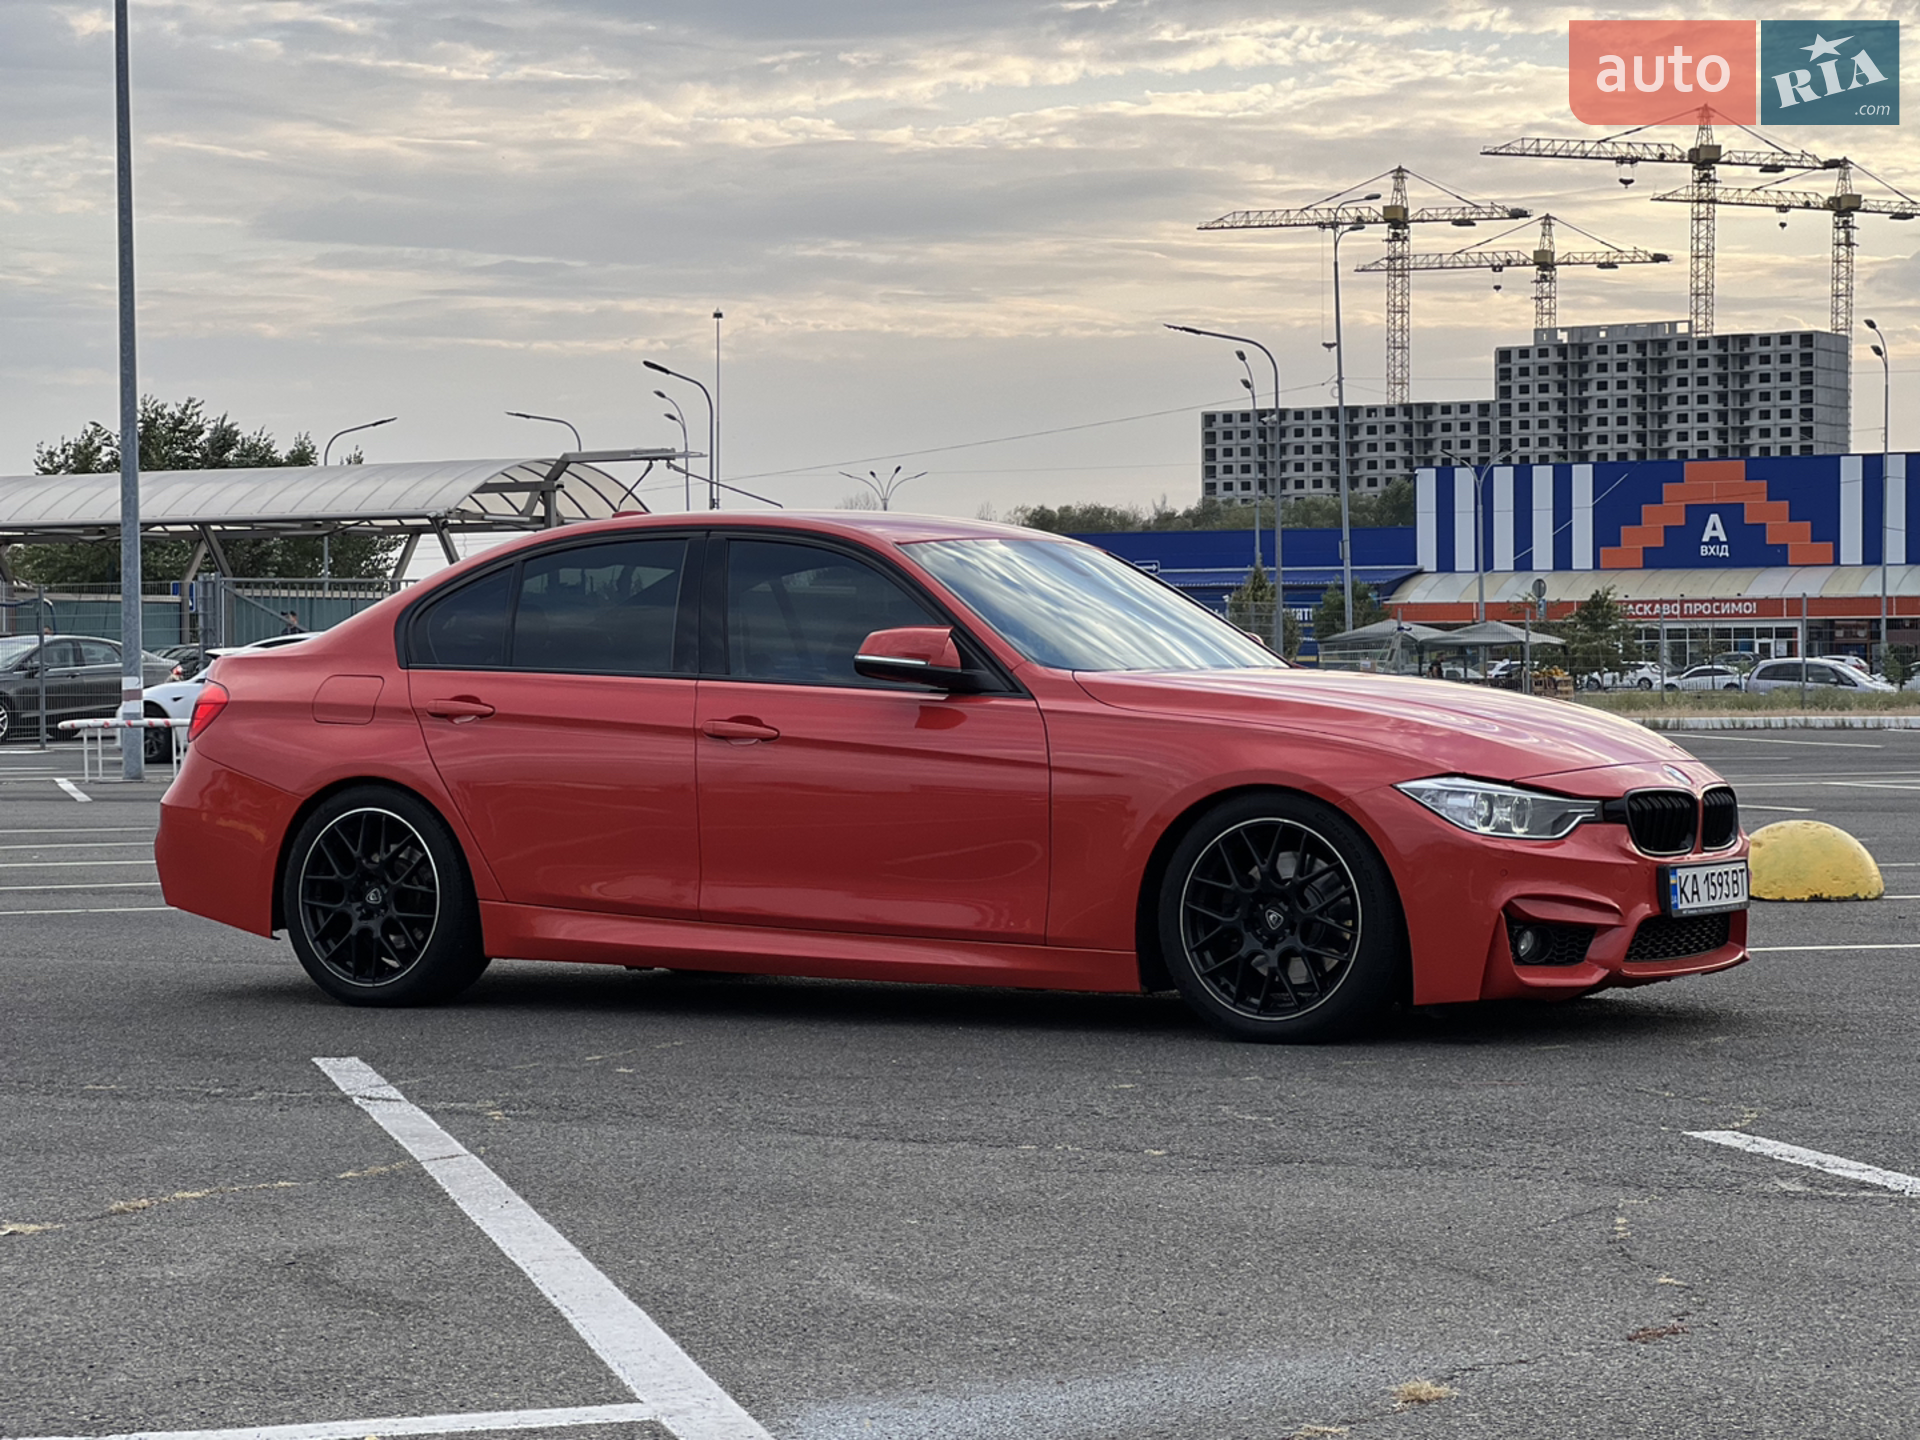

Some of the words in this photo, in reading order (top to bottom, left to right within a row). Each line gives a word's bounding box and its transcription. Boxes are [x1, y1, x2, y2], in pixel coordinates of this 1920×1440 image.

[1702, 513, 1727, 542] А
[1700, 544, 1729, 558] ВХІД
[1683, 602, 1757, 614] ПРОСИМО!
[1679, 874, 1700, 904] KA
